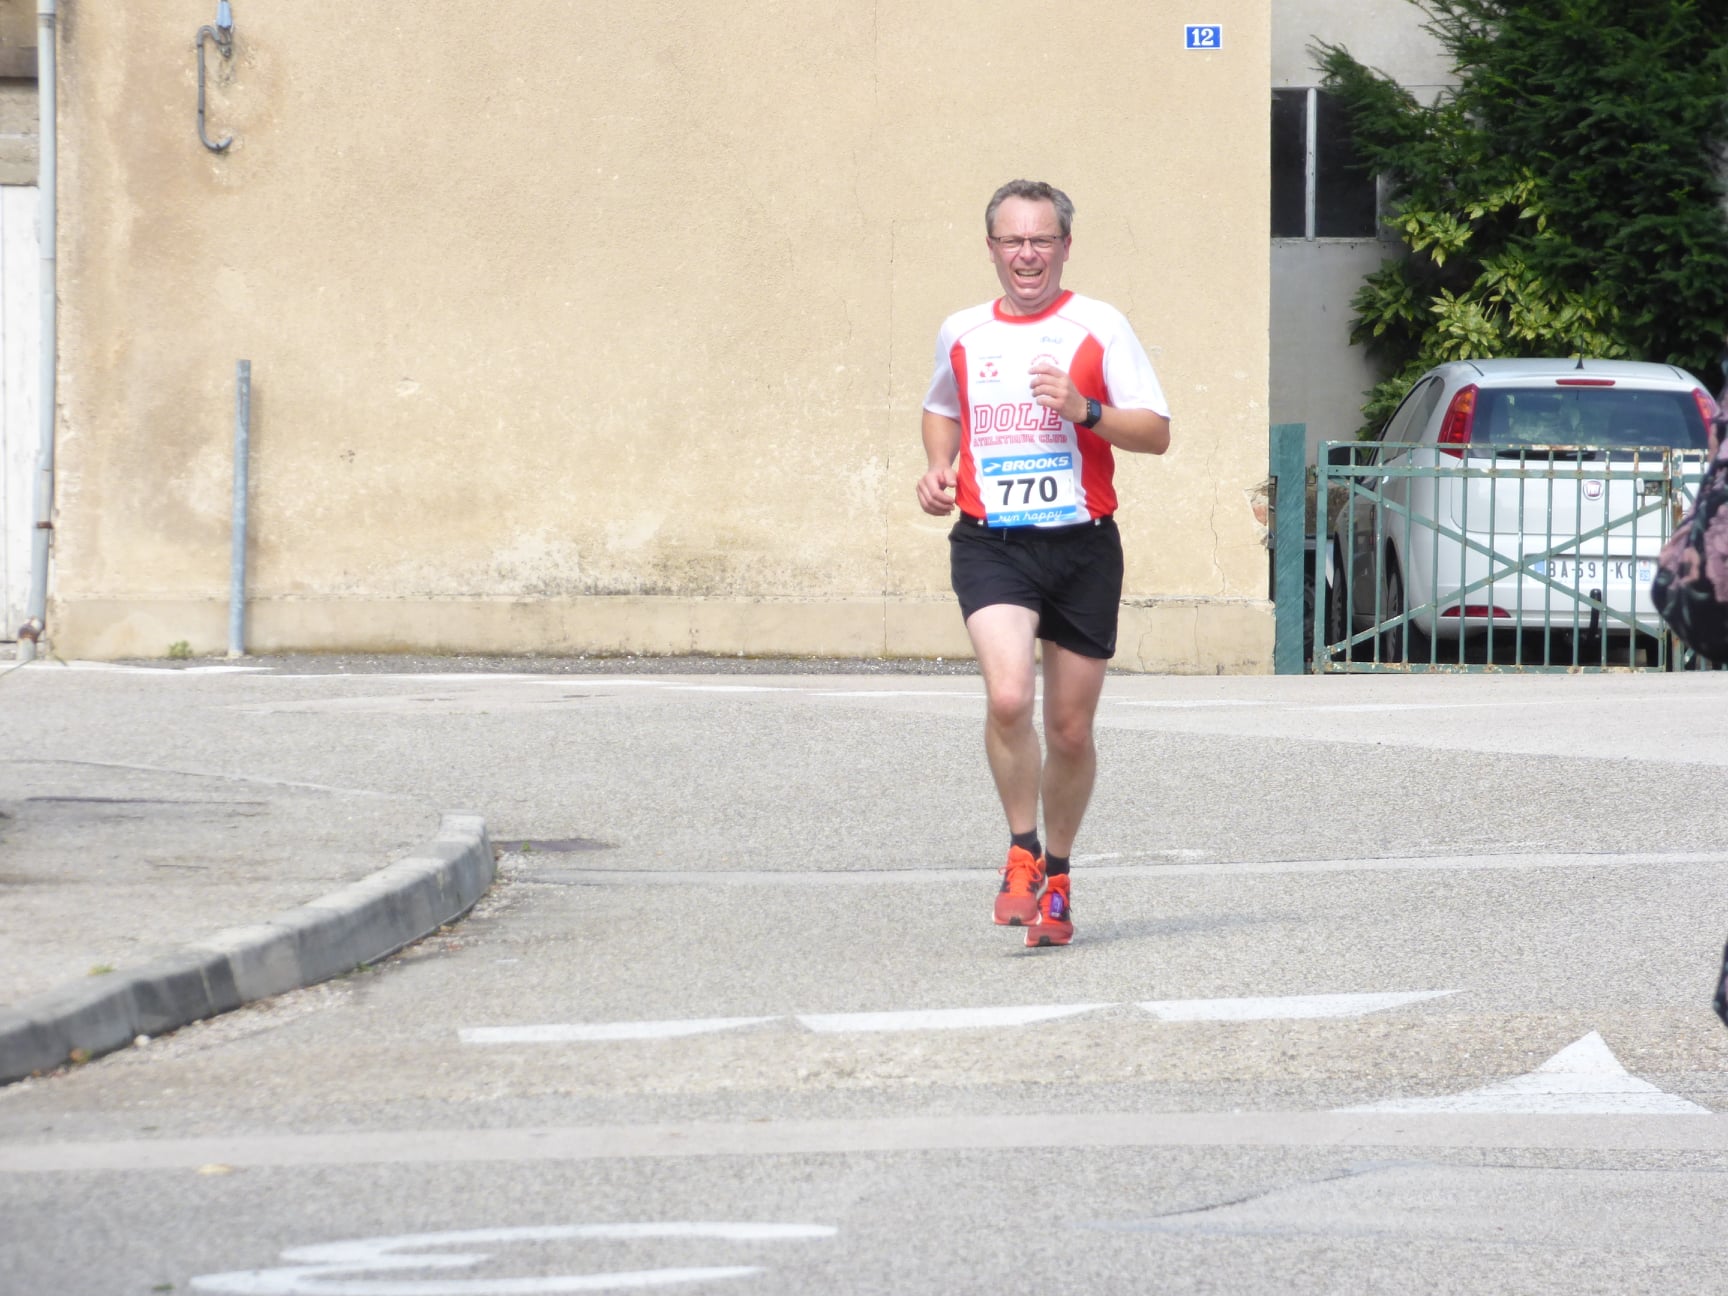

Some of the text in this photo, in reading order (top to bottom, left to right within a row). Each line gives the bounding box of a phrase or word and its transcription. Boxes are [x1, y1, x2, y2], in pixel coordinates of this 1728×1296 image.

[1191, 28, 1214, 46] 12
[974, 402, 1063, 434] DOLE
[1039, 433, 1068, 444] CLUB
[1001, 456, 1069, 472] BROOKS
[997, 475, 1058, 506] 770
[998, 510, 1063, 523] run happy
